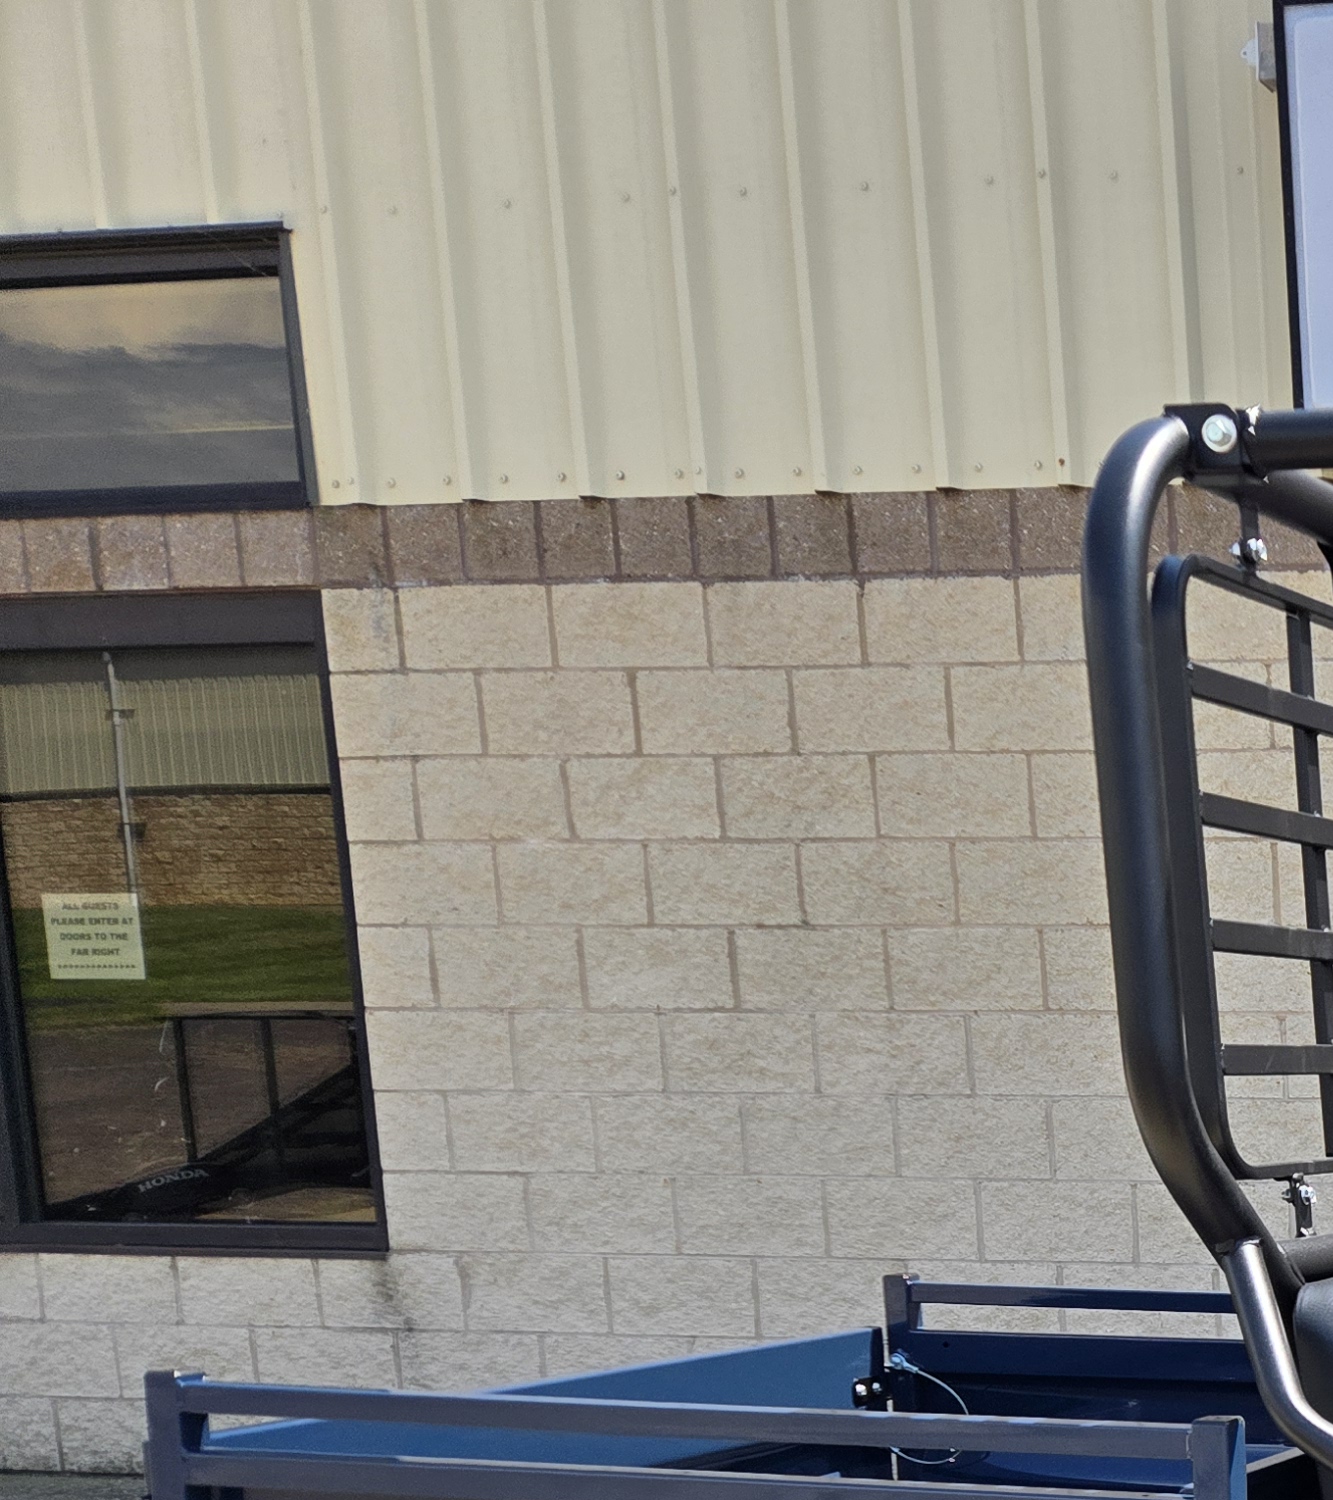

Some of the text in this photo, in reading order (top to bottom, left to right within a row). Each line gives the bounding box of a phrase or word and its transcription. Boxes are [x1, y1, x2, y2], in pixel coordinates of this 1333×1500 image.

[50, 917, 134, 925] PLEASE ENTER AT
[60, 933, 92, 941] DOORS
[110, 933, 129, 941] THE
[71, 948, 120, 956] FAR RIGHT
[137, 1168, 209, 1193] HONDA
